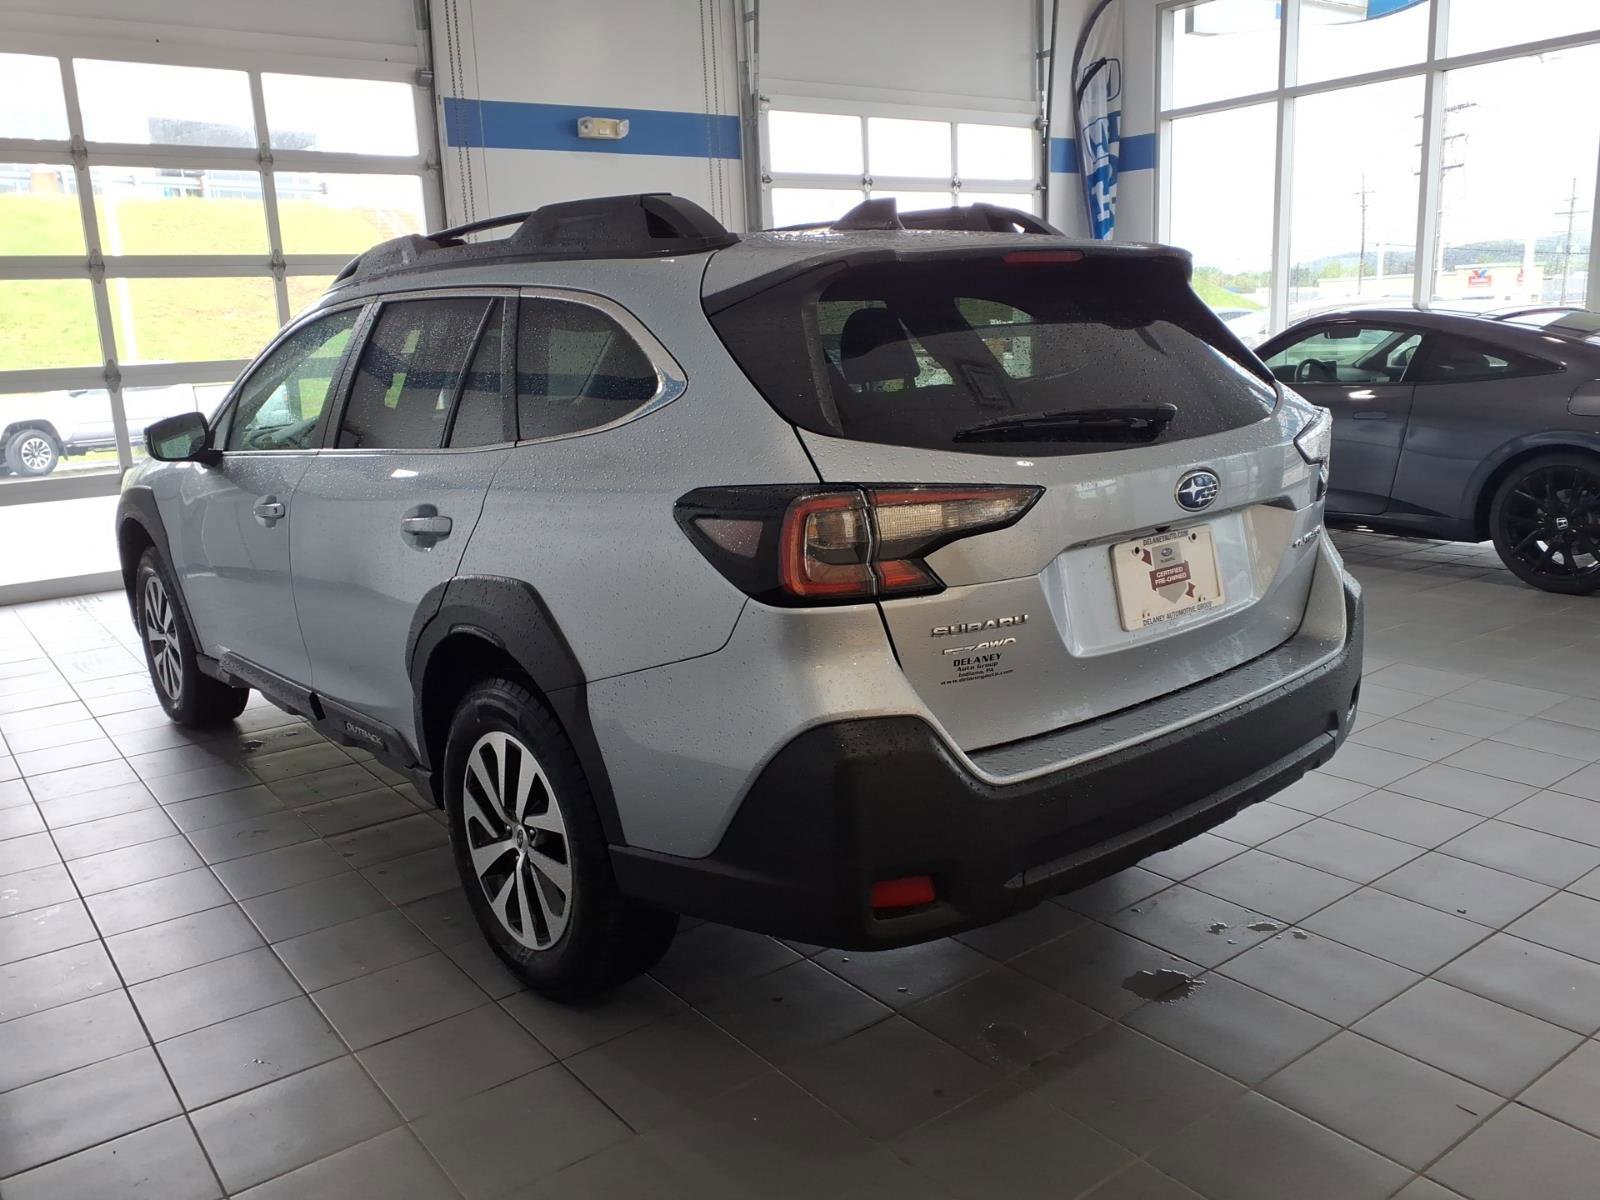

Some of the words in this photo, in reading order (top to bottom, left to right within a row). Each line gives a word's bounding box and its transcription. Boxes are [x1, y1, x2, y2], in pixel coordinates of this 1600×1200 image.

[1155, 572, 1187, 585] PRE-OWNED
[1156, 566, 1184, 578] CERTIFIED
[1143, 615, 1165, 626] DELANEY
[1166, 606, 1196, 618] AUTOMOTIVE
[931, 614, 1029, 637] SUBARU
[953, 653, 1002, 667] DELANEY
[977, 661, 999, 669] Group
